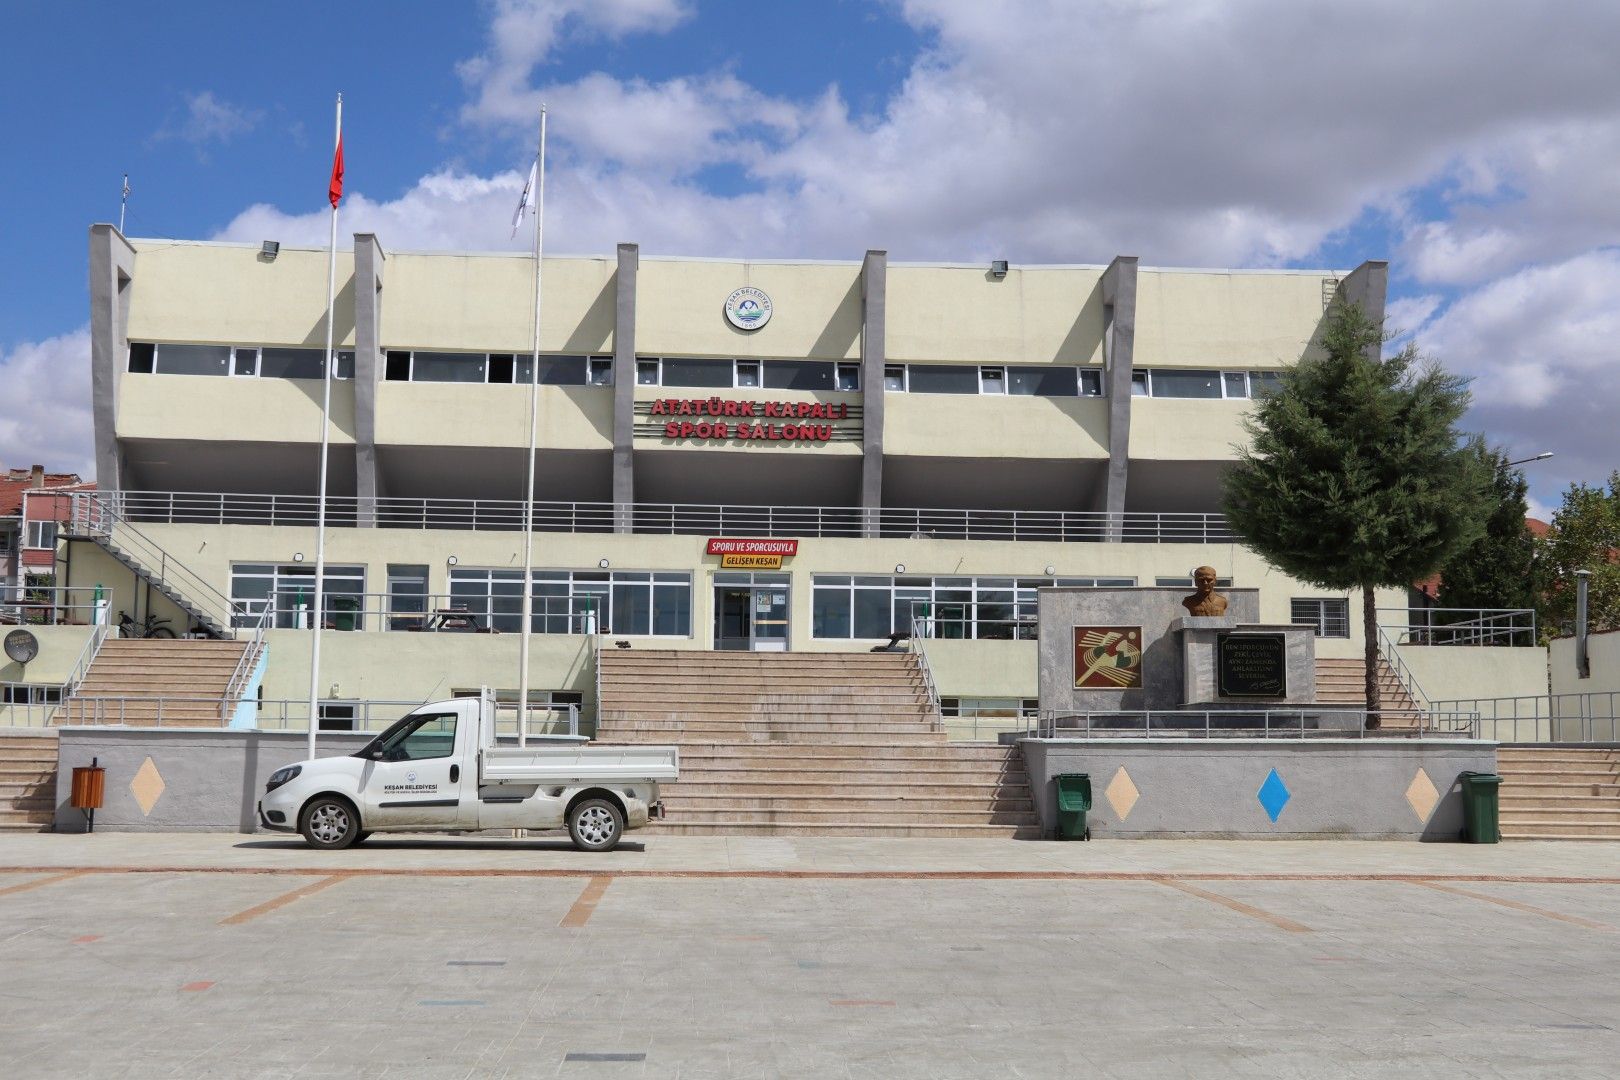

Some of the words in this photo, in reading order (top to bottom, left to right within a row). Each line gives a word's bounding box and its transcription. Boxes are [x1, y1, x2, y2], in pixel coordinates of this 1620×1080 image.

[651, 397, 755, 416] ATATÜRK
[665, 421, 728, 438] SPOR
[736, 422, 832, 441] SALONU
[712, 542, 735, 551] SPORU
[736, 543, 744, 551] VE
[745, 542, 794, 552] SPORCUSUYLA
[726, 556, 755, 566] GELİŞEN
[755, 556, 778, 566] KEŞAN
